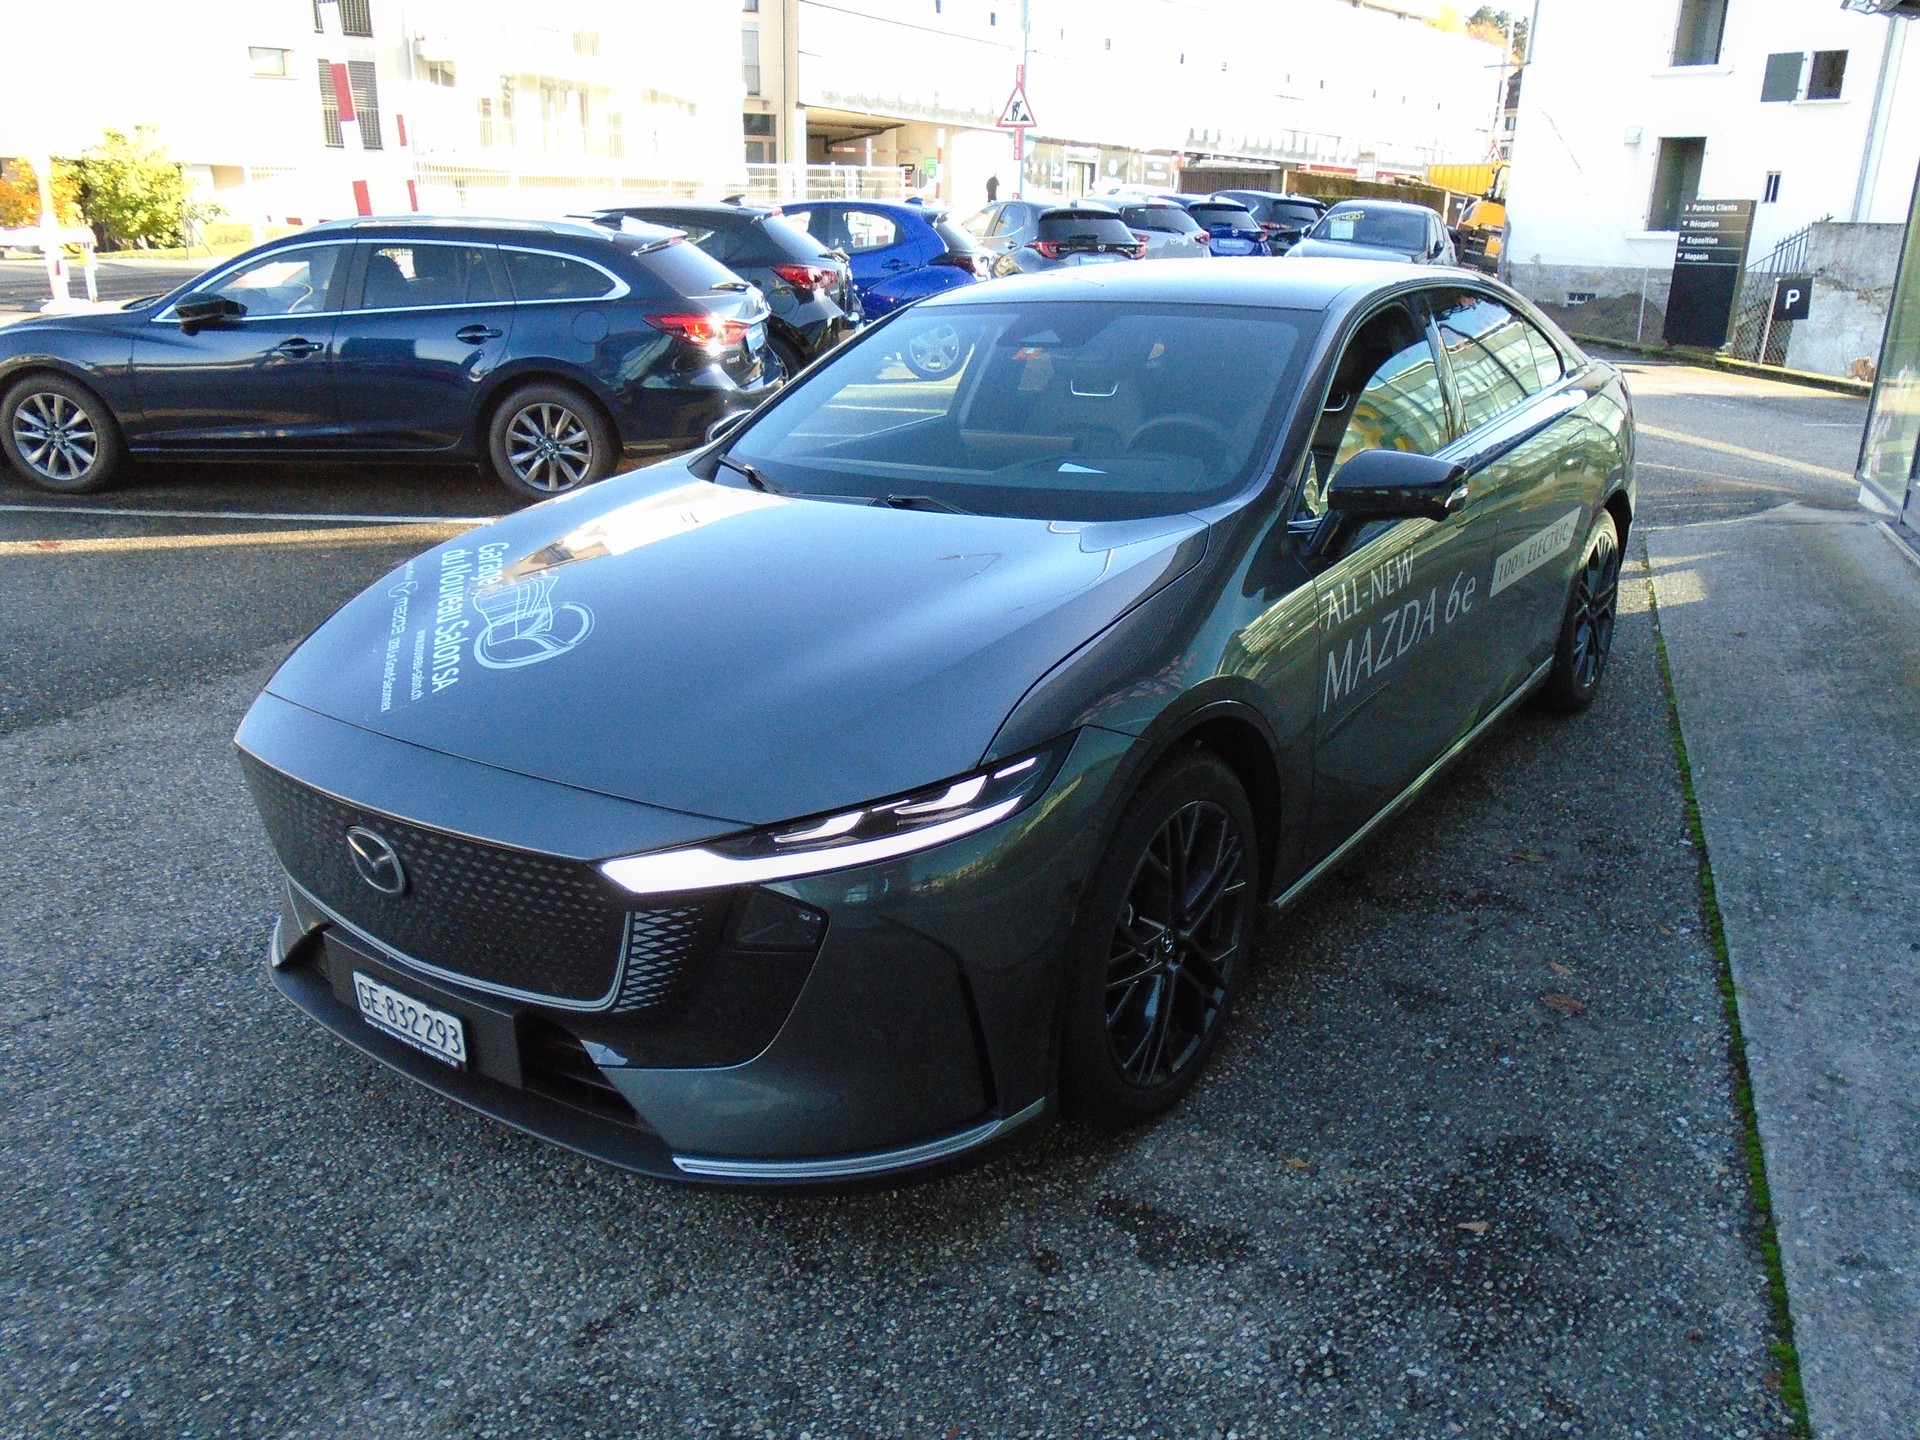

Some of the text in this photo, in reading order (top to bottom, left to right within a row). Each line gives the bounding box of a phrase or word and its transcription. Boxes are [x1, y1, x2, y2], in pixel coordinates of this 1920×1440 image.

[1689, 220, 1720, 229] Réception
[1692, 204, 1738, 212] Parking Clients
[1683, 253, 1709, 261] Magasin
[1686, 237, 1719, 246] Exposition
[1785, 289, 1800, 309] P
[470, 542, 510, 586] Garage
[1499, 522, 1569, 583] 100% ELECTRIC
[1326, 549, 1413, 631] ALL-NEW
[391, 597, 408, 635] mazda
[431, 549, 473, 693] du Nouveau Salon SA
[1323, 571, 1476, 713] MAZDA 6e
